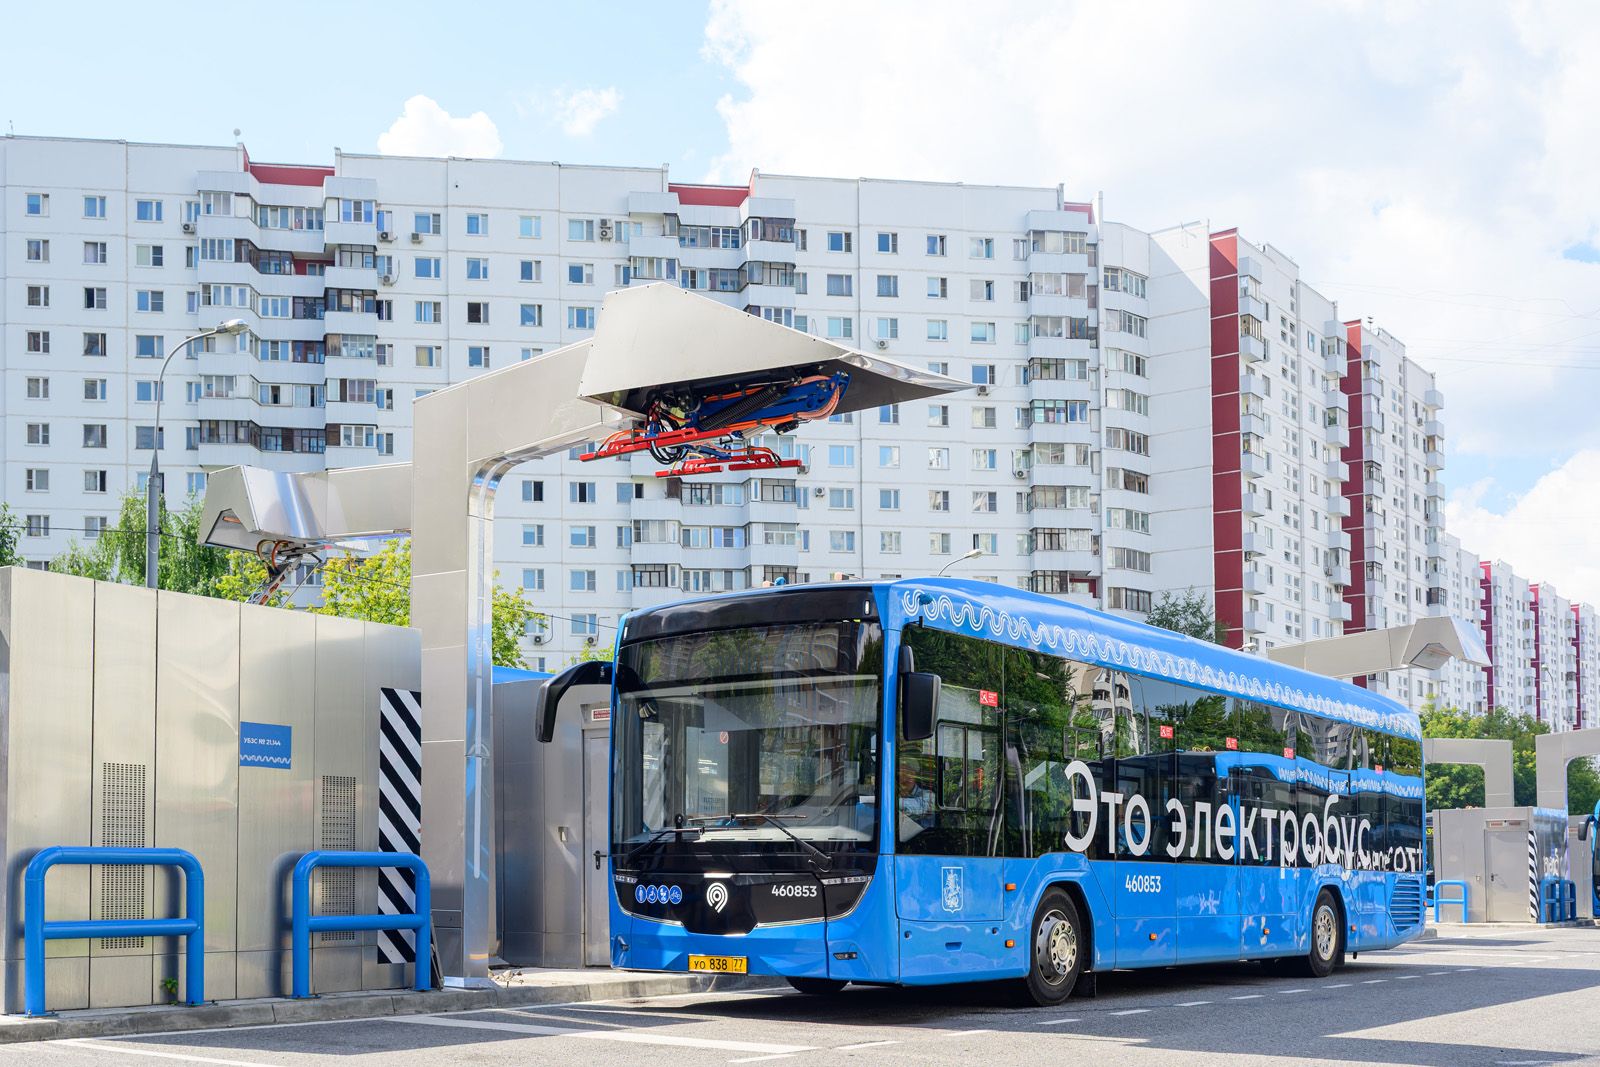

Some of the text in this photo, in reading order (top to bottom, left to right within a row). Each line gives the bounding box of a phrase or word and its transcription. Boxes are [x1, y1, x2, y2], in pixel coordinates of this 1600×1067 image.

[1064, 760, 1371, 880] Это электробус
[771, 884, 817, 897] 460853
[1125, 874, 1162, 893] 460853
[709, 958, 728, 971] 838
[733, 958, 743, 968] 77
